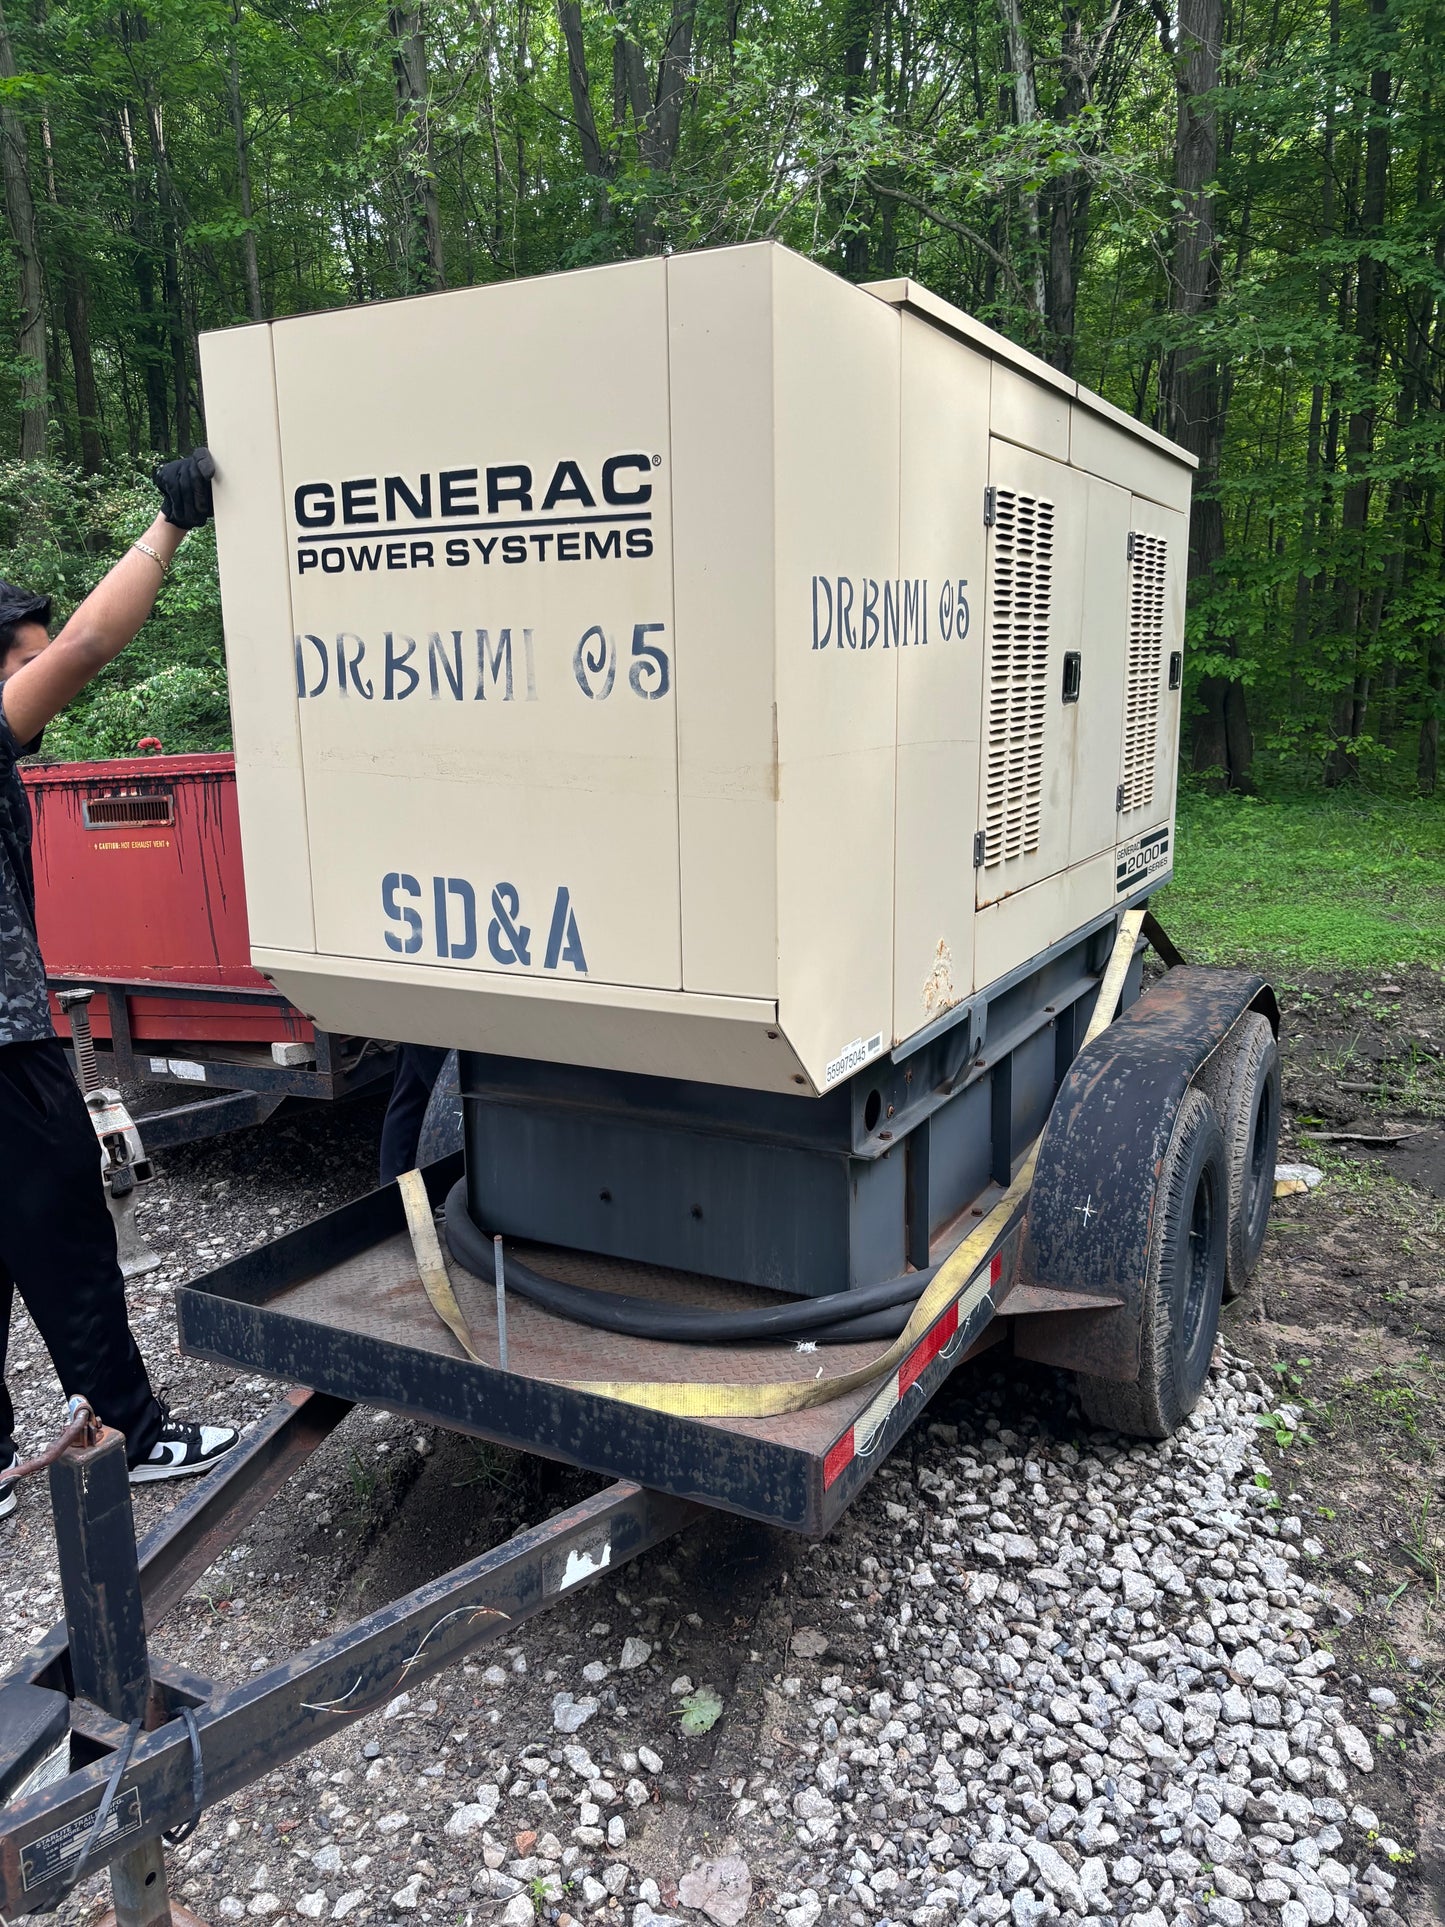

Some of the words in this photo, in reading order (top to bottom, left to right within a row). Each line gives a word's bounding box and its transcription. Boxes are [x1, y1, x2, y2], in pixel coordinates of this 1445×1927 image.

[297, 540, 435, 575] POWER
[445, 527, 654, 567] SYSTEMS
[811, 575, 929, 650] DRBNMI
[938, 579, 970, 642] 05
[294, 627, 540, 701] DRBNMI
[572, 622, 670, 701] 05
[121, 841, 130, 849] HOT
[131, 840, 152, 849] EXHAUST
[152, 840, 165, 848] VENT
[1116, 841, 1140, 861] GENERAC
[1127, 844, 1160, 875] 2000
[1148, 856, 1168, 874] SERIES
[381, 871, 589, 972] SD&A
[826, 1045, 866, 1082] 559975045
[35, 1825, 72, 1849] STARLITE
